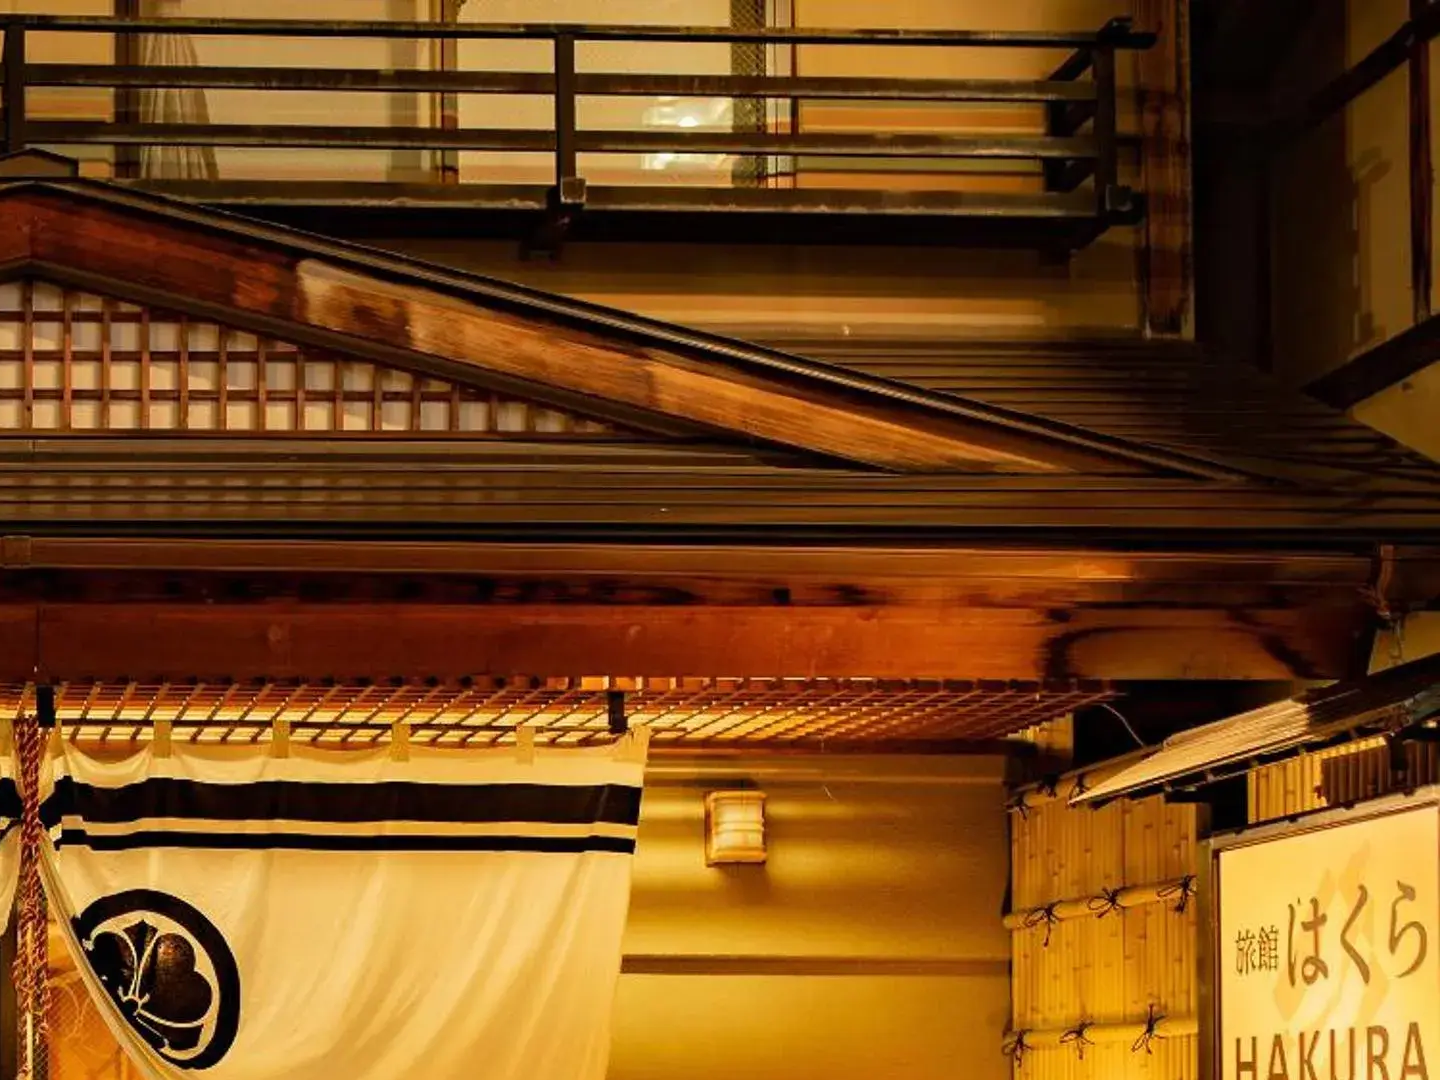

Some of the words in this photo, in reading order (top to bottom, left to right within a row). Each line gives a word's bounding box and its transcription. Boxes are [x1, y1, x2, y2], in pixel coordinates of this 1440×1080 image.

[1235, 924, 1279, 976] 旅館
[1287, 880, 1428, 988] はくら
